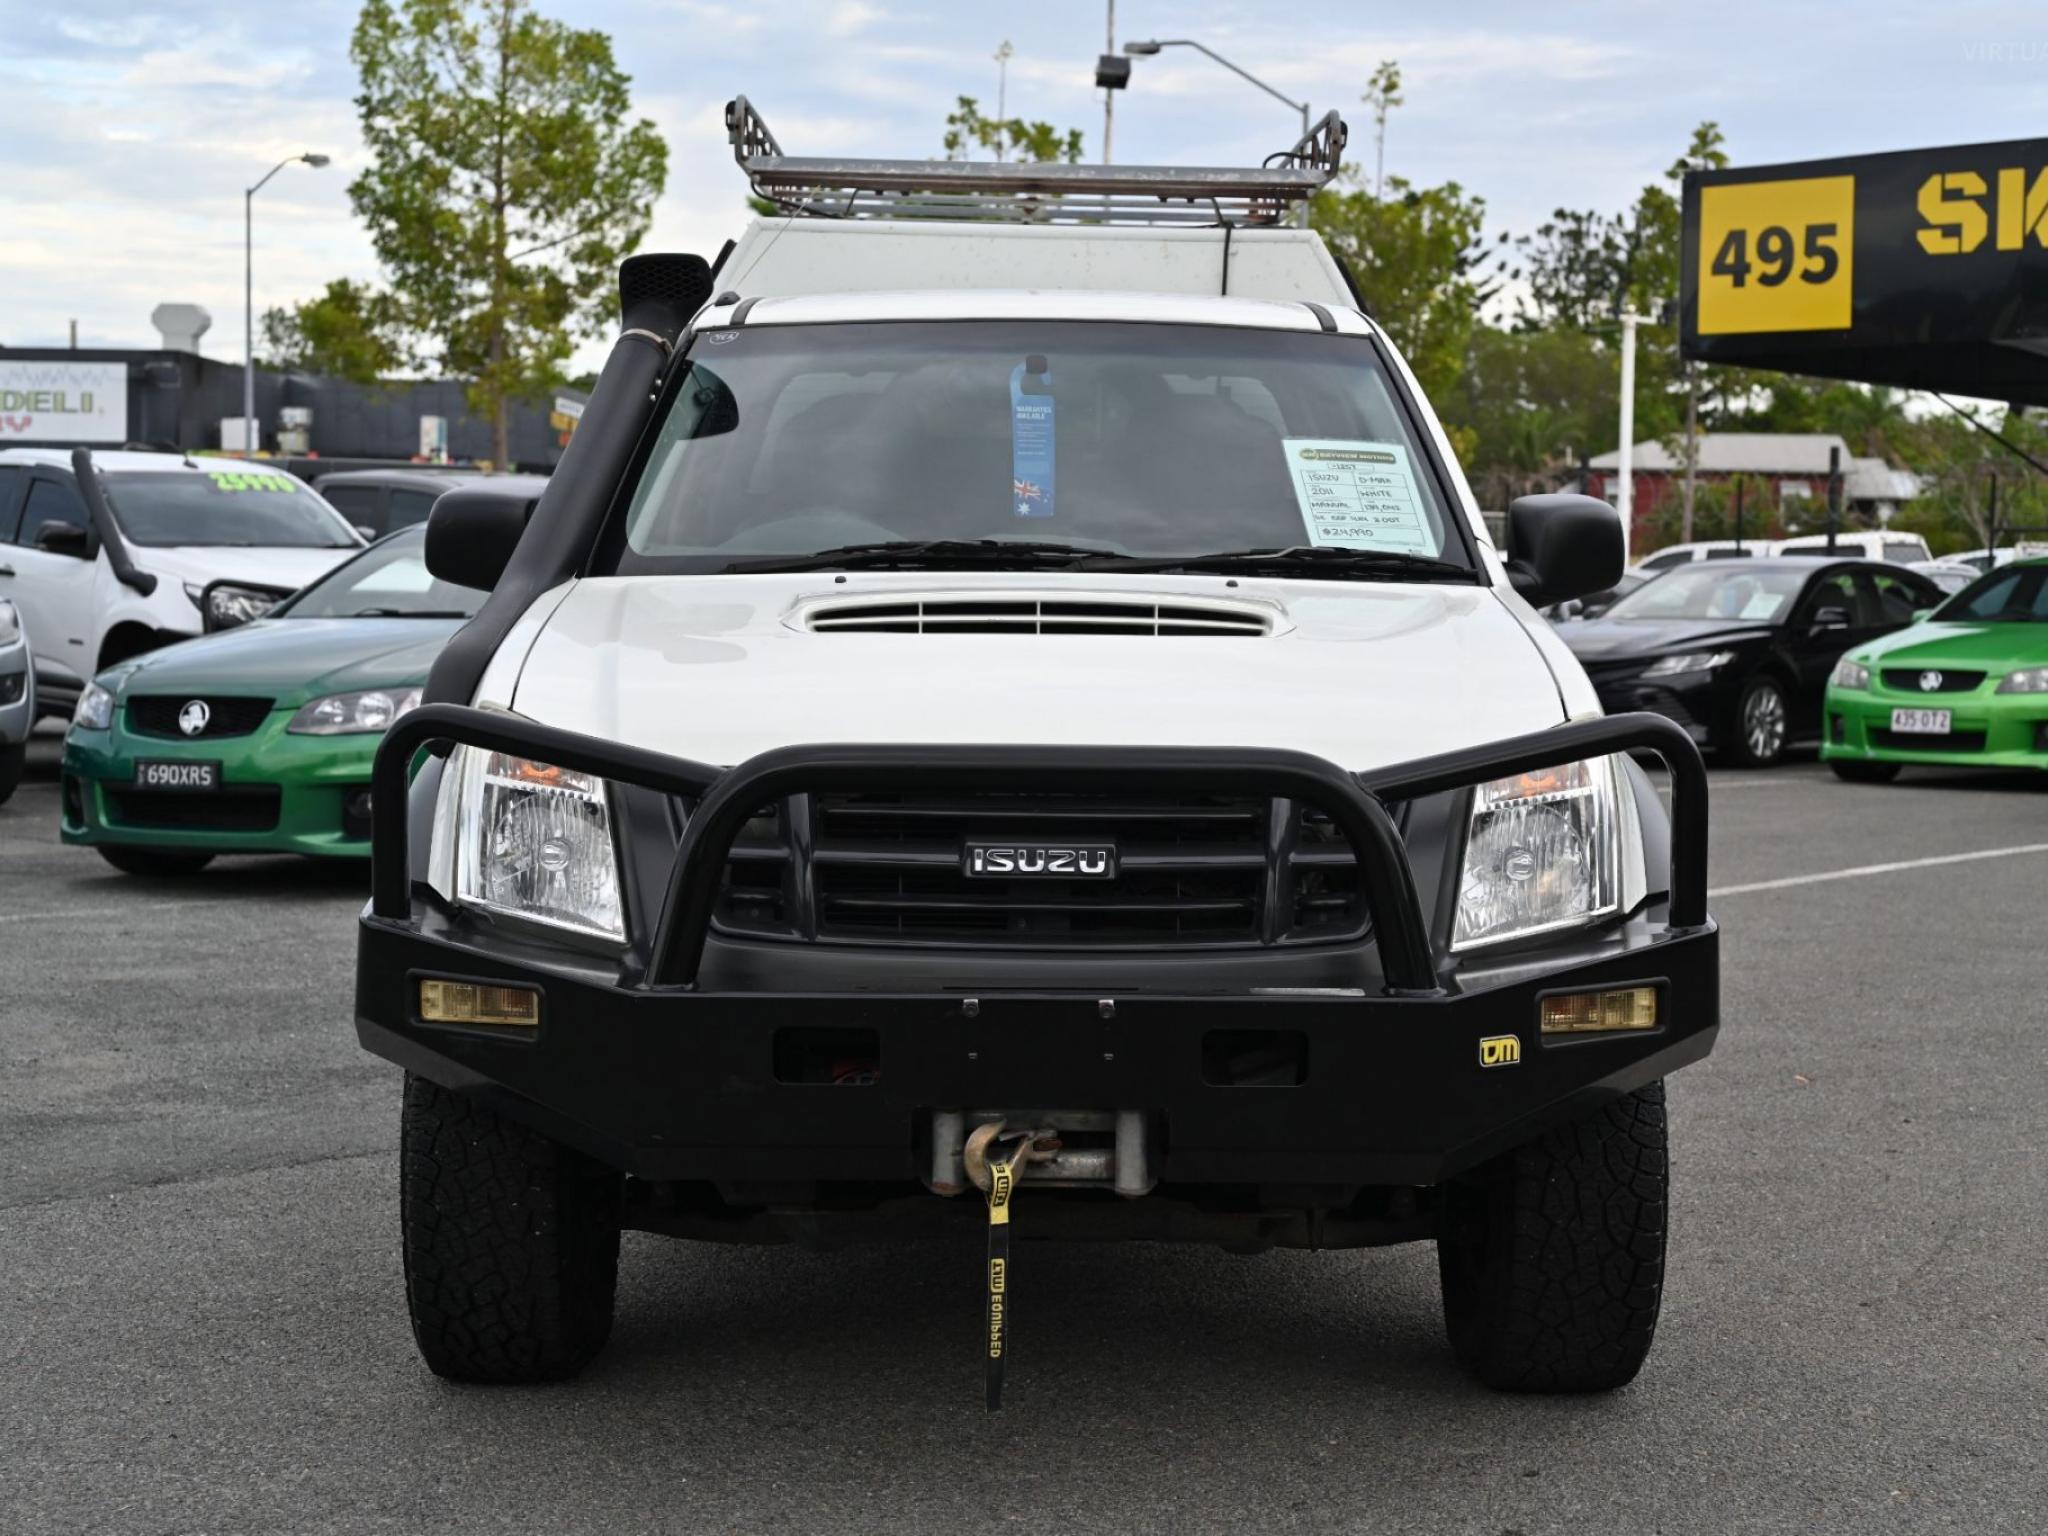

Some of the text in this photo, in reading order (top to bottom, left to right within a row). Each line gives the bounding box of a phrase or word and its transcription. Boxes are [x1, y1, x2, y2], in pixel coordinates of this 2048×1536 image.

[1711, 222, 1839, 289] 495
[147, 763, 212, 786] 690XRS
[973, 848, 1106, 873] ISUZU
